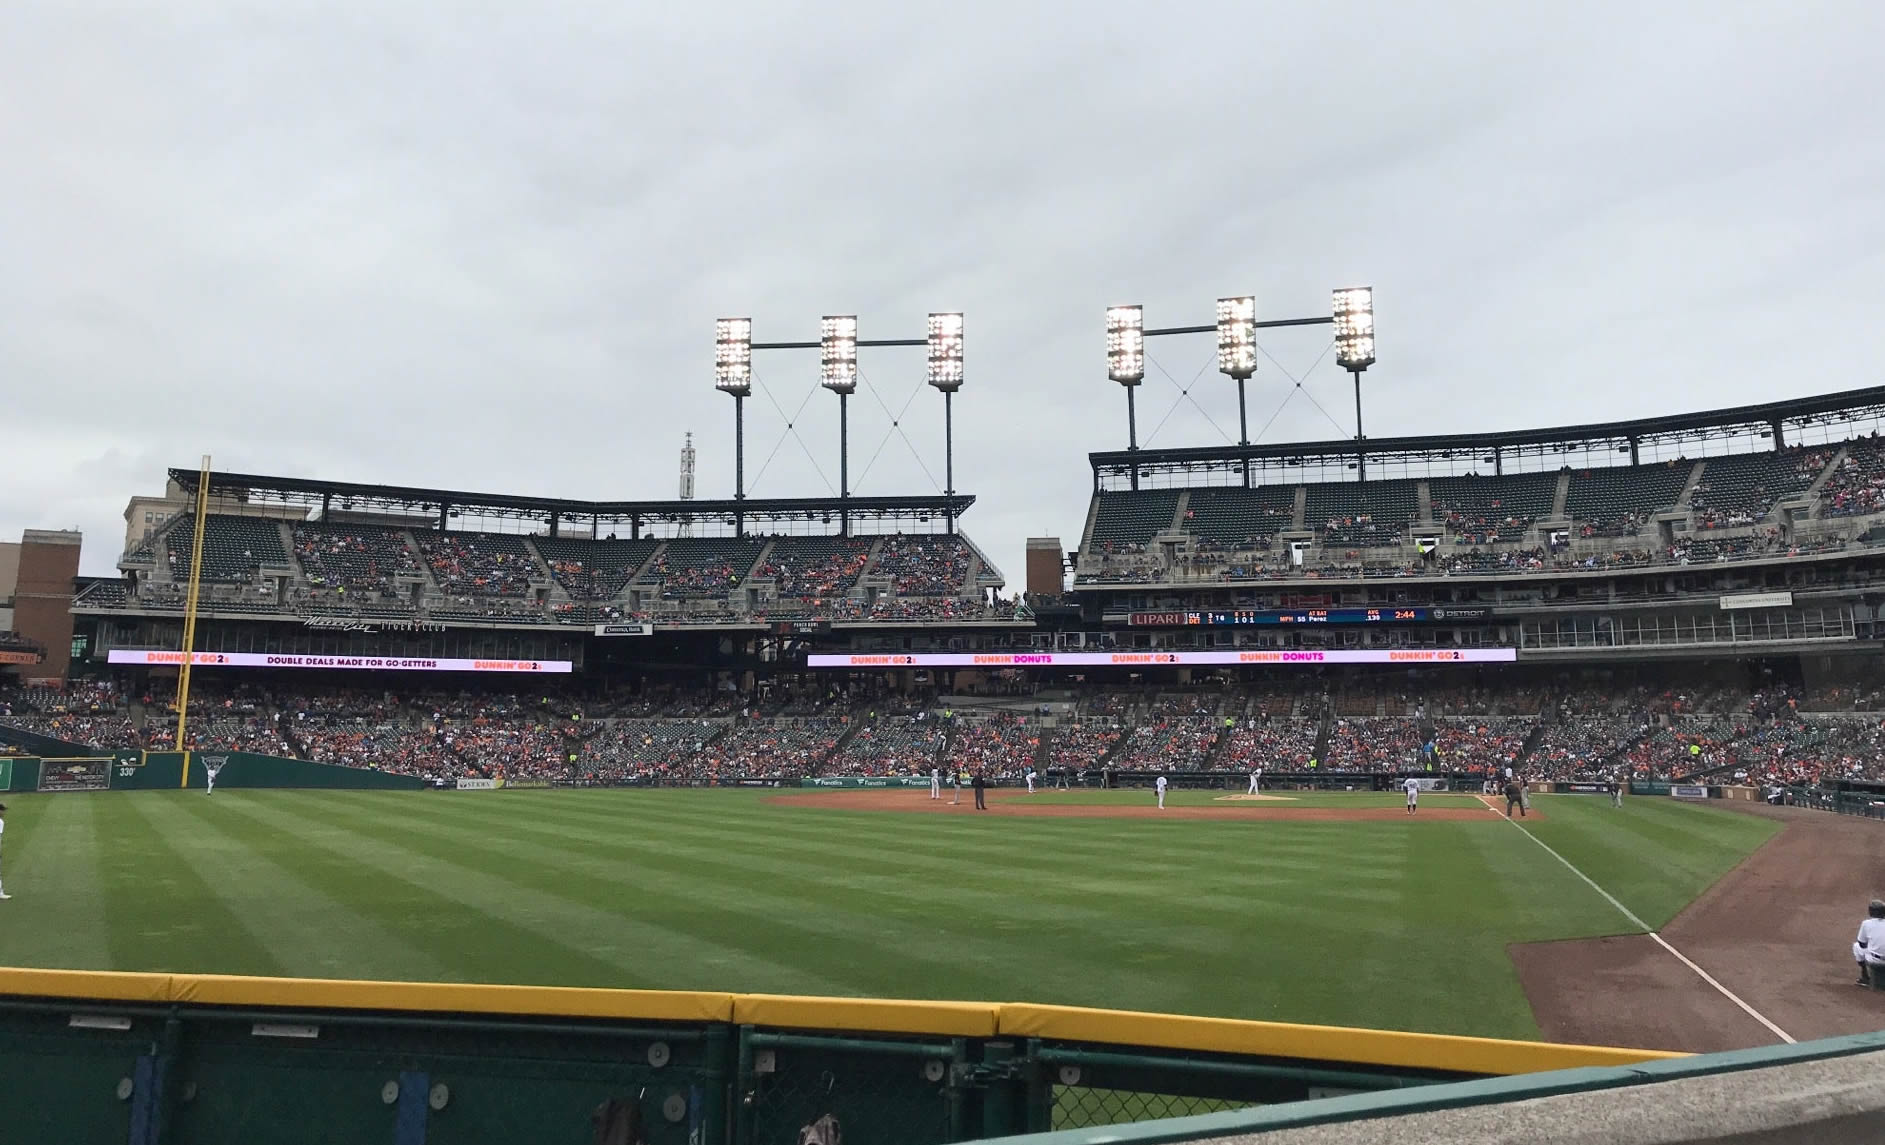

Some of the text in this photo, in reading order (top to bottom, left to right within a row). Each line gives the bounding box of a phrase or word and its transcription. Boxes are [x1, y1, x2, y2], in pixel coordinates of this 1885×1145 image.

[1136, 613, 1179, 624] LIPARI
[1394, 610, 1415, 619] 2:44
[381, 621, 446, 632] TIGER CLUB
[850, 655, 892, 664] DUNKIN'
[1112, 654, 1154, 663] DUNKIN'
[1390, 651, 1436, 660] DUNKIN'
[267, 656, 437, 668] DOUBLE DEALS MADE FOR GO-GETTERS
[474, 660, 517, 669] DUNKIN'
